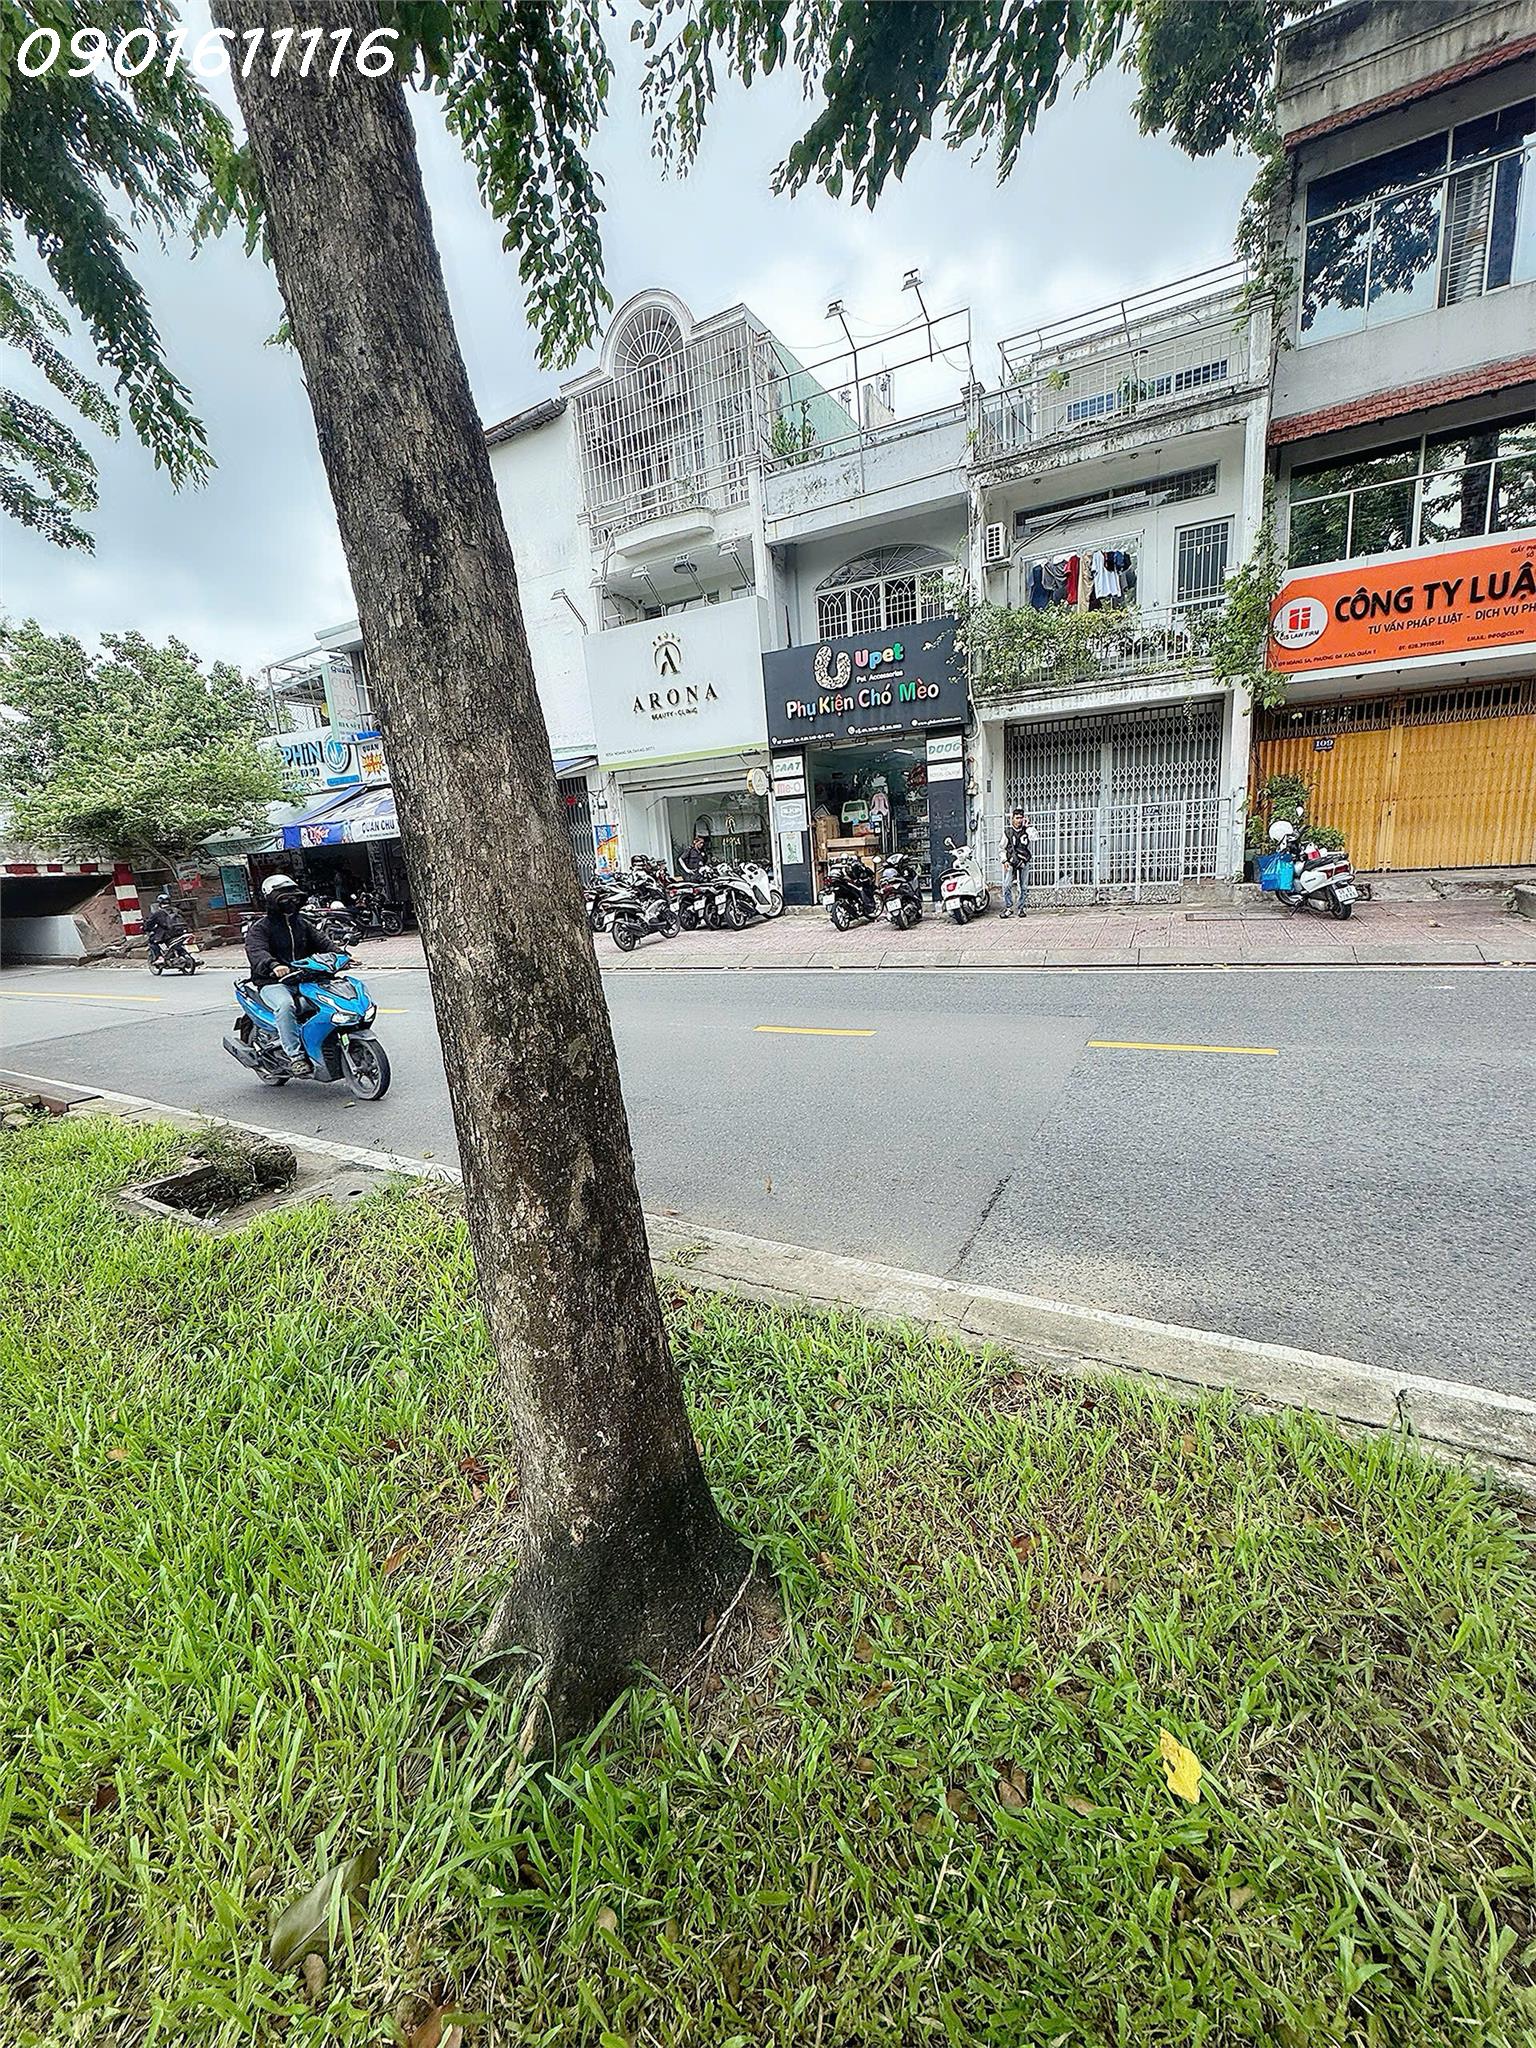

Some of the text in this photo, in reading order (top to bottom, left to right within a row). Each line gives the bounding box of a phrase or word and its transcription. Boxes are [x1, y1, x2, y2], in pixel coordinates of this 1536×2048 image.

[1335, 587, 1413, 622] CÔNG
[1424, 578, 1463, 610] TY
[1407, 616, 1435, 630] PHÁP
[1437, 613, 1463, 626] LUẬT
[1475, 607, 1500, 620] DỊCH
[1503, 604, 1519, 616] VỤ
[855, 642, 904, 670] Upet
[633, 682, 719, 714] ARONA
[786, 678, 939, 722] Phụ Kiện Chó Mèo
